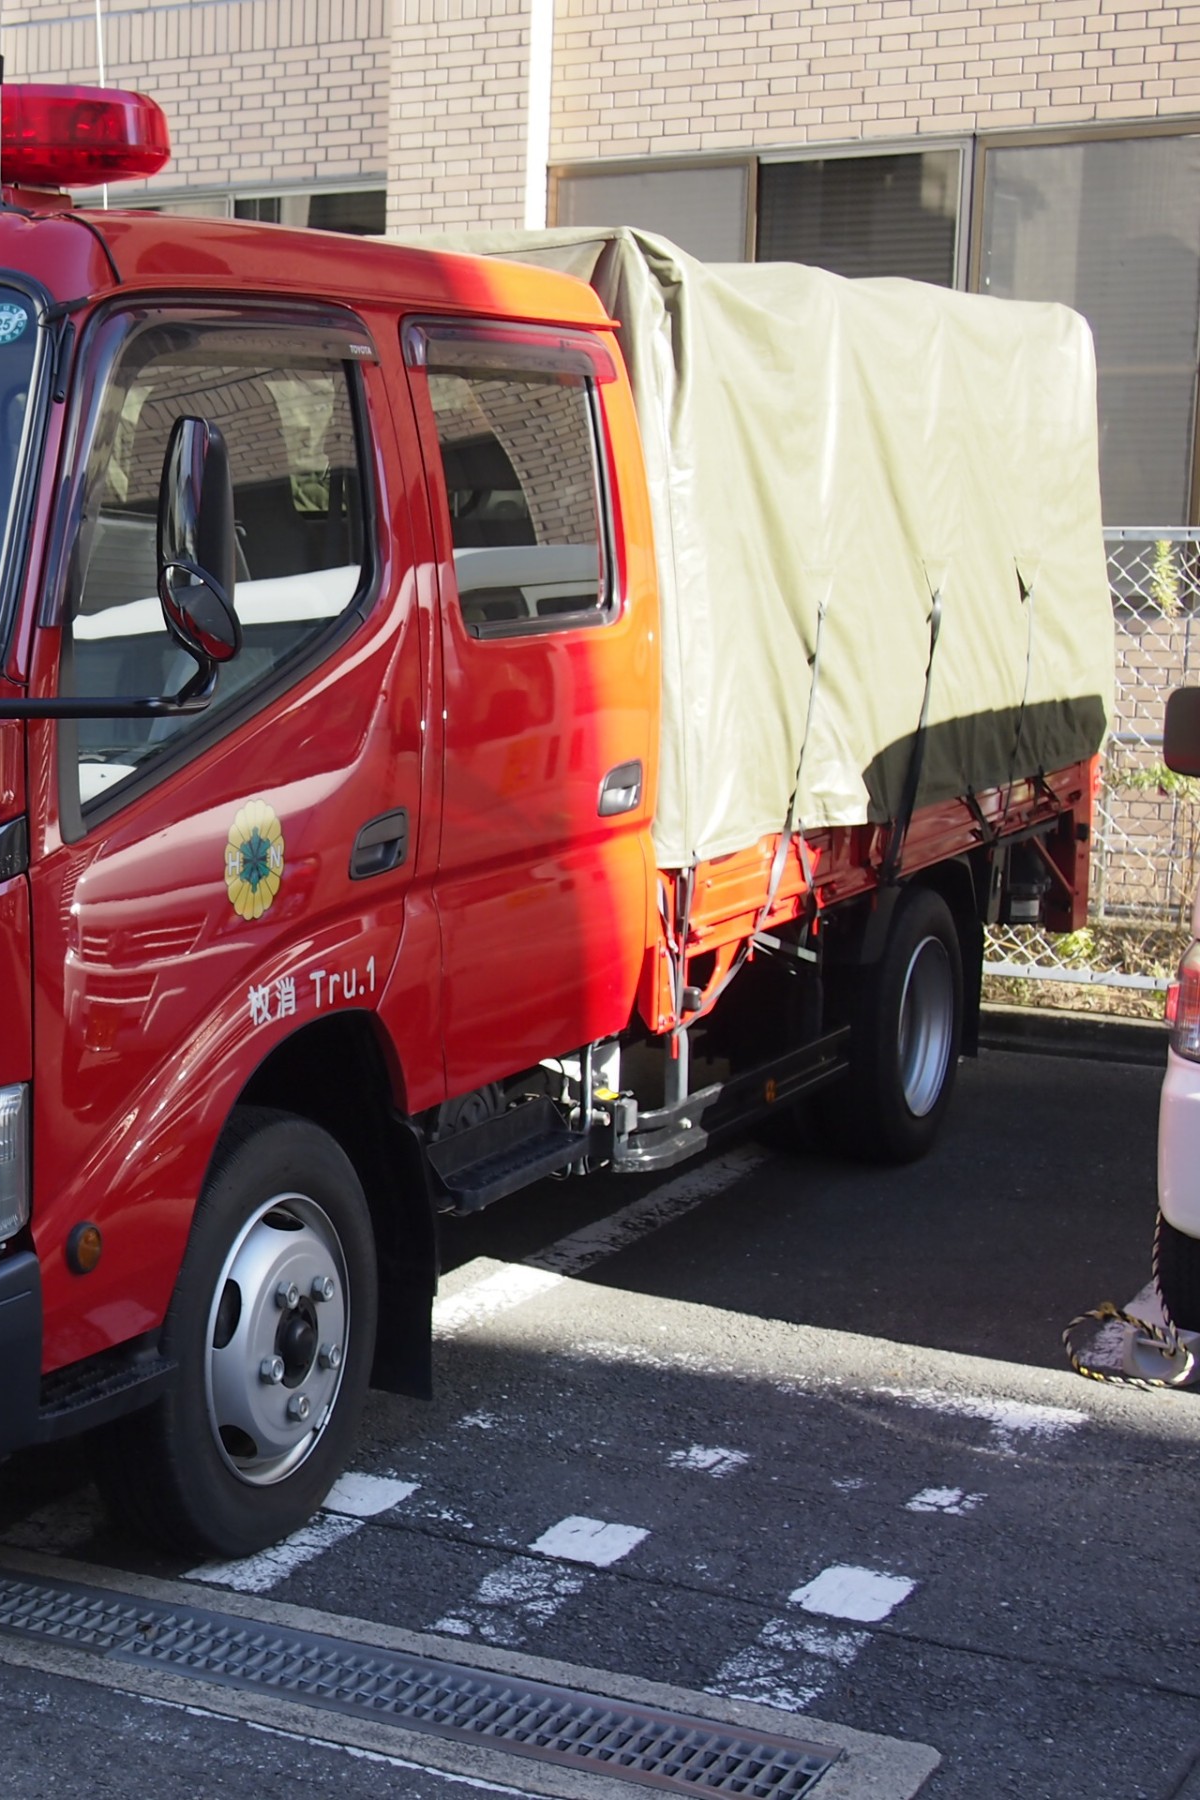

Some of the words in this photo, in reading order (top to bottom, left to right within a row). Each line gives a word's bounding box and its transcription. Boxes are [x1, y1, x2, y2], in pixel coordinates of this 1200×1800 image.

[349, 344, 372, 355] TOYOTA
[228, 851, 240, 876] H
[270, 845, 281, 868] N
[309, 955, 376, 1008] Tru.1
